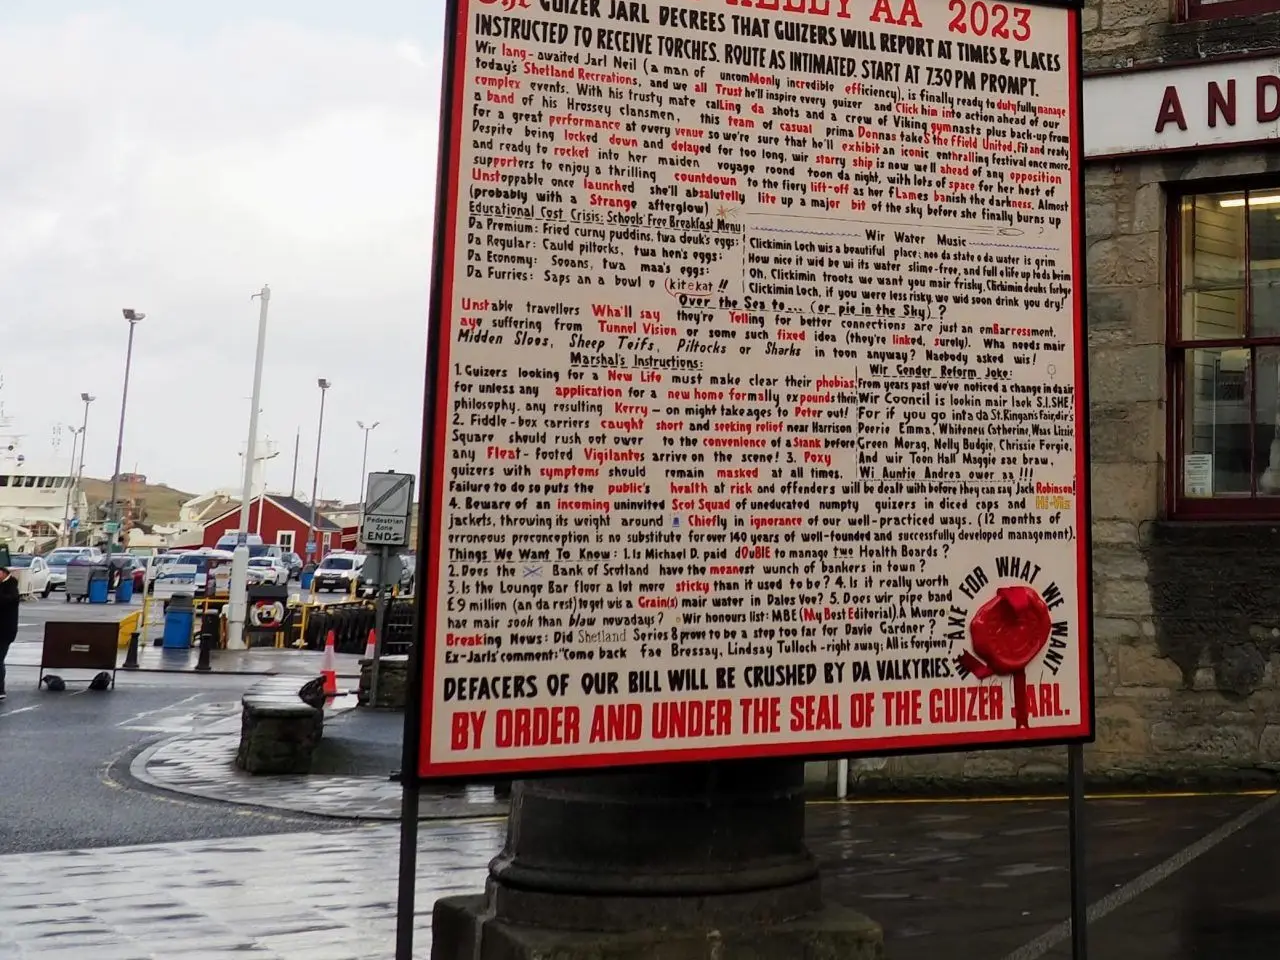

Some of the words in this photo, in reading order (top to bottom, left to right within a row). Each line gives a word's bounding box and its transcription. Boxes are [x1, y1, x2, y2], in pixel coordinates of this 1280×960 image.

[607, 0, 650, 24] JARL
[659, 5, 726, 33] DECREES
[731, 14, 770, 39] THAT
[774, 20, 837, 47] GUIZERS
[840, 28, 876, 51] WILL
[879, 32, 935, 58] REPORT
[937, 40, 953, 60] AT
[957, 42, 997, 65] TIMES
[999, 47, 1011, 67] &
[1014, 49, 1061, 72] PLACES
[475, 13, 569, 45] INSTRUCTED
[573, 25, 593, 48] TO
[597, 28, 653, 55] RECEIVE
[657, 35, 720, 63] TORCHES.
[724, 43, 767, 68] ROUTE
[768, 49, 786, 70] AS
[789, 51, 858, 78] INTIMATED.
[861, 59, 901, 83] START
[904, 64, 921, 84] AT
[954, 69, 977, 90] PM
[980, 72, 1039, 97] PROMPT.
[584, 52, 607, 67] Jarl
[613, 55, 637, 71] Neil
[919, 88, 948, 104] finally
[956, 96, 984, 112] ready
[523, 61, 574, 79] Shetland
[715, 83, 743, 98] Trust
[996, 113, 1026, 126] ahead
[474, 76, 521, 90] complex
[576, 82, 603, 98] With
[893, 114, 929, 134] Viking
[487, 90, 514, 104] band
[567, 97, 611, 118] Hrossey
[728, 113, 755, 128] team
[512, 110, 543, 124] great
[549, 113, 621, 130] performance
[674, 127, 704, 138] venue
[472, 119, 513, 137] Despite
[564, 129, 598, 143] locked
[671, 140, 711, 156] delayed
[1010, 171, 1062, 184] opposition
[554, 145, 589, 158] rocket
[658, 153, 700, 168] maiden
[717, 162, 755, 176] voyage
[473, 155, 534, 169] supporters
[608, 164, 656, 184] thrilling
[674, 172, 737, 186] countdown
[810, 181, 849, 195] lift-off
[583, 175, 635, 194] launched
[469, 183, 528, 205] (probably
[536, 190, 563, 203] with
[590, 193, 638, 213] Strange
[648, 198, 709, 218] afterglow)
[469, 197, 534, 220] Educational
[865, 229, 885, 242] Wir
[894, 231, 926, 244] Water
[937, 233, 967, 247] Music
[843, 243, 885, 257] beautiful
[615, 274, 641, 288] bowl
[678, 293, 710, 308] Over
[526, 301, 580, 316] travellers
[841, 318, 907, 335] connections
[597, 319, 637, 334] Tunnel
[642, 322, 677, 336] Vision
[457, 328, 503, 344] Midden
[569, 333, 605, 352] Sheep
[765, 341, 801, 357] Sharks
[570, 351, 627, 369] Marshal's
[518, 367, 560, 383] looking
[608, 369, 633, 382] New
[640, 367, 662, 383] Life
[894, 361, 932, 379] Gender
[940, 364, 977, 380] Reform
[555, 385, 623, 399] application
[615, 401, 648, 418] Kerry
[600, 417, 644, 433] caught
[812, 421, 852, 434] Harrison
[856, 419, 890, 435] Peerie
[703, 432, 766, 448] convenience
[583, 447, 645, 465] Vigilantes
[962, 452, 997, 469] Maggie
[540, 465, 600, 480] symptoms
[717, 467, 759, 479] masked
[608, 482, 650, 496] public's
[670, 481, 708, 494] health
[557, 494, 611, 514] incoming
[672, 498, 695, 511] Scot
[698, 498, 731, 513] Squad
[366, 516, 404, 525] Pedestrian
[375, 524, 393, 532] Zone
[750, 514, 802, 530] ignorance
[1000, 513, 1042, 530] months
[512, 530, 590, 547] preconception
[627, 530, 682, 544] substitute
[448, 547, 489, 564] Things
[645, 548, 686, 560] Michael
[901, 544, 938, 558] Boards
[552, 561, 583, 577] Bank
[603, 563, 649, 576] Scotland
[995, 555, 1041, 584] WHAT
[500, 580, 543, 598] Lounge
[675, 580, 710, 595] sticky
[915, 574, 949, 587] worth
[959, 565, 989, 600] FOR
[927, 589, 953, 603] band
[1041, 581, 1064, 611] WE
[446, 632, 502, 649] Breaking
[879, 621, 925, 638] Gardner
[727, 641, 773, 658] Lindsay
[776, 639, 817, 654] Tulloch
[1042, 621, 1068, 676] WANT
[443, 675, 538, 702] DEFACERS
[546, 673, 570, 697] OF
[581, 671, 619, 695] OUR
[628, 670, 662, 694] BILL
[667, 668, 709, 692] WILL
[716, 667, 736, 689] BE
[743, 663, 817, 688] CRUSHED
[823, 662, 846, 684] BY
[852, 661, 872, 683] DA
[876, 658, 956, 681] VALKYRIES.
[451, 710, 487, 751] BY
[495, 705, 580, 748] ORDER
[589, 703, 643, 744] AND
[651, 699, 732, 739] UNDER
[739, 696, 781, 735] THE
[790, 694, 842, 732] SEAL
[850, 692, 875, 729] OF
[882, 689, 922, 727] THE
[929, 685, 1004, 724] GUIZER
[1011, 683, 1070, 719] ARL.
